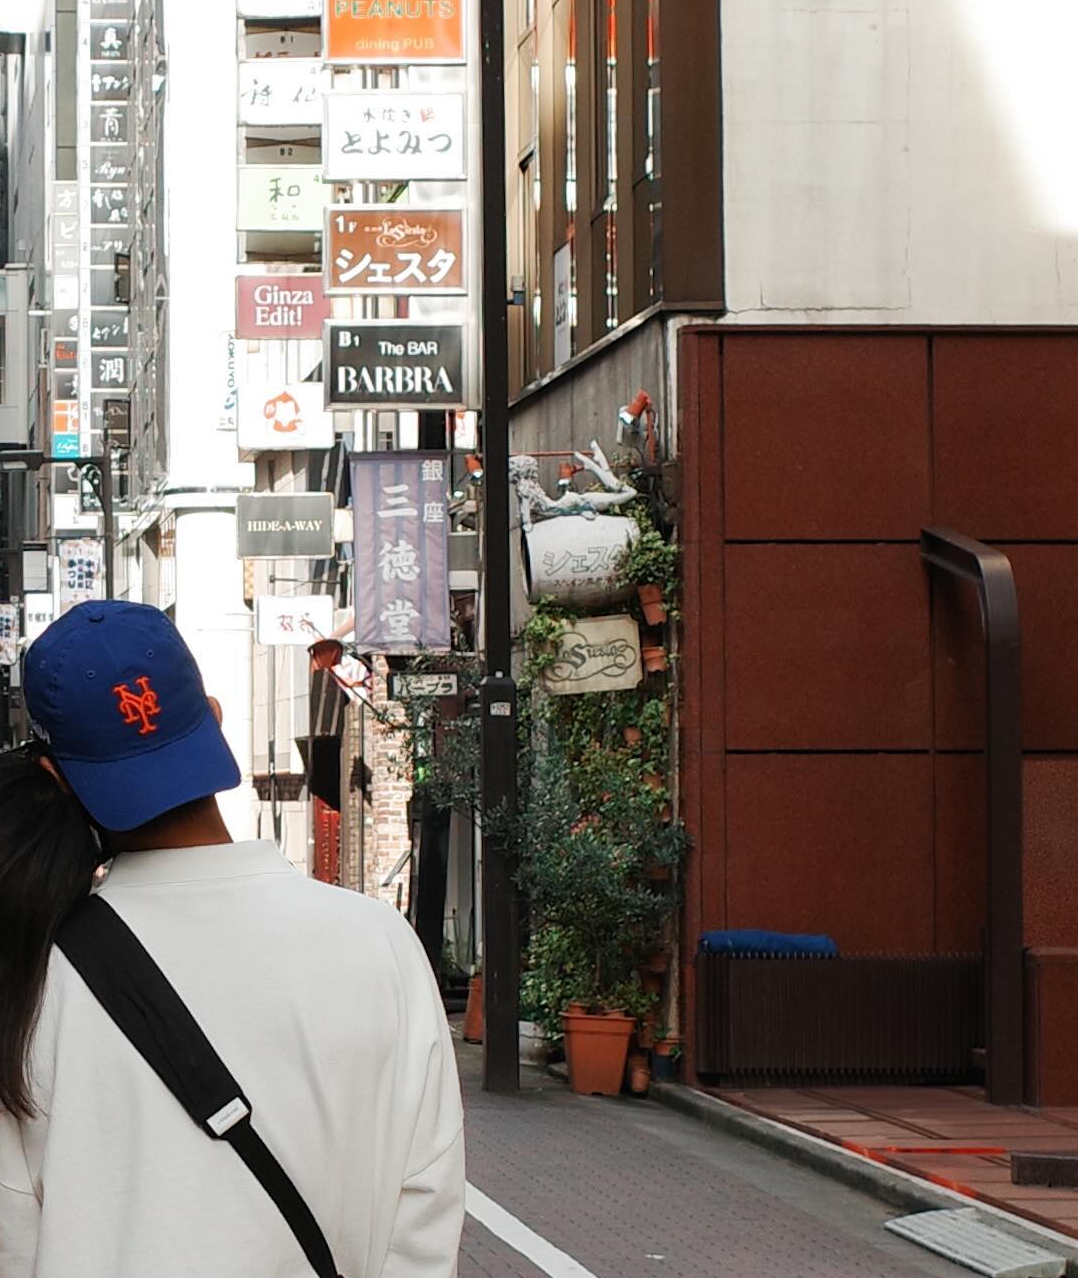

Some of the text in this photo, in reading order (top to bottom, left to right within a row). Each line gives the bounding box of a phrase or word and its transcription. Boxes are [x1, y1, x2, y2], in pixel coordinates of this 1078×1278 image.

[356, 36, 435, 52] dining PUB
[340, 130, 452, 155] とよみつ
[335, 248, 457, 284] シェスタ
[254, 285, 313, 305] Ginza
[255, 306, 303, 327] Edit!
[339, 331, 360, 348] B1
[379, 341, 438, 355] The BAR
[337, 366, 453, 394] BARBRA
[422, 460, 444, 523] 銀座
[247, 520, 323, 532] HIDE-A-WAY
[377, 483, 419, 641] 三徳堂
[112, 675, 162, 735] NY
